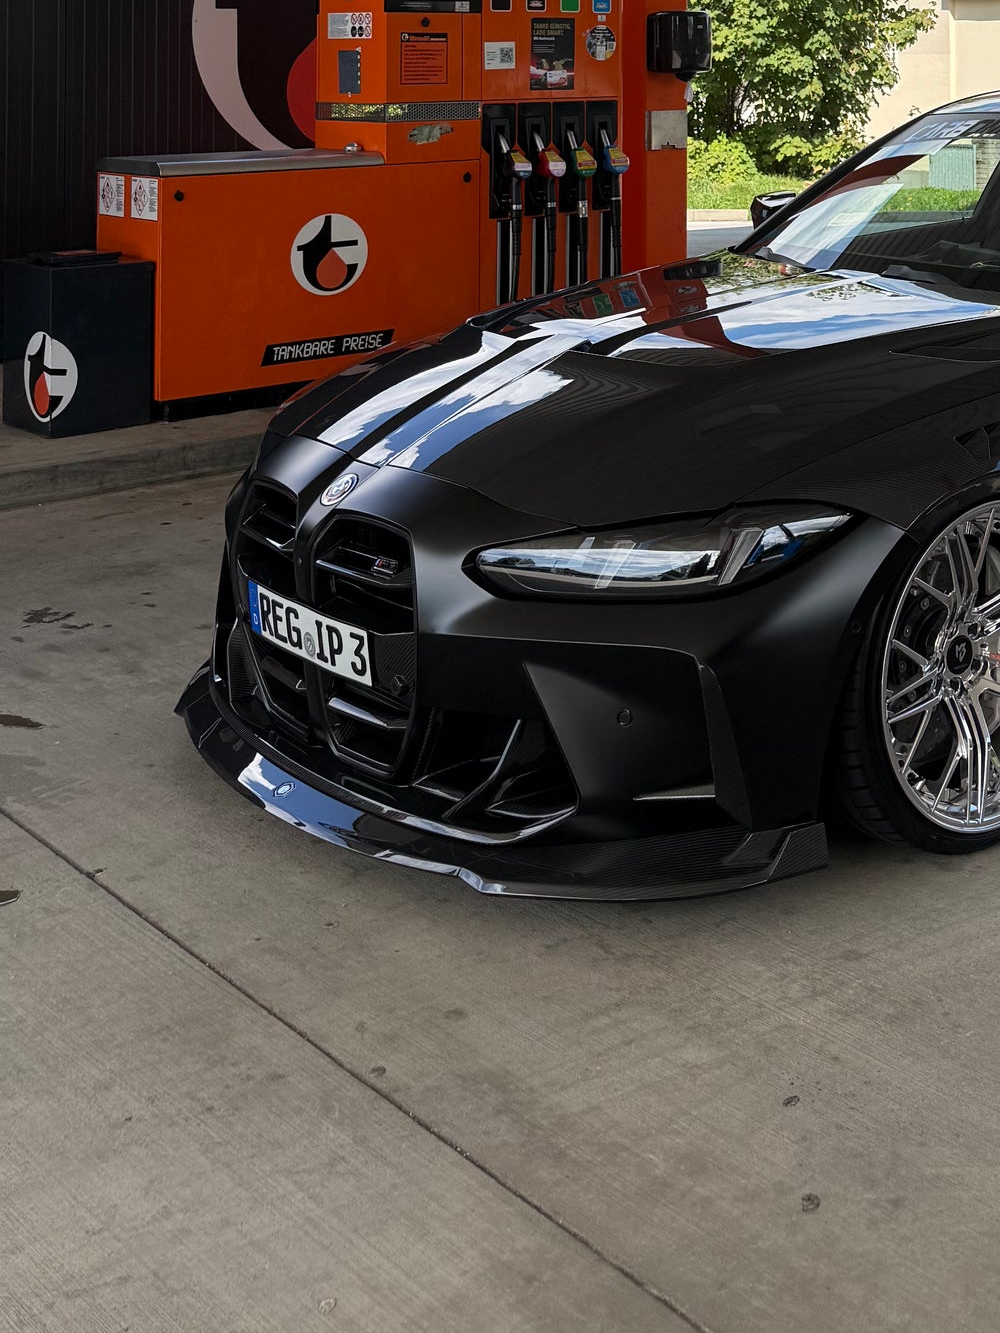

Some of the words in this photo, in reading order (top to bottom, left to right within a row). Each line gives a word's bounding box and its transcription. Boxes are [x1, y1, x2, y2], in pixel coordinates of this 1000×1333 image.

[273, 340, 336, 361] TANKBARE
[342, 334, 383, 352] PREISE
[259, 592, 303, 650] REG
[315, 619, 343, 666] IP
[349, 632, 367, 676] 3
